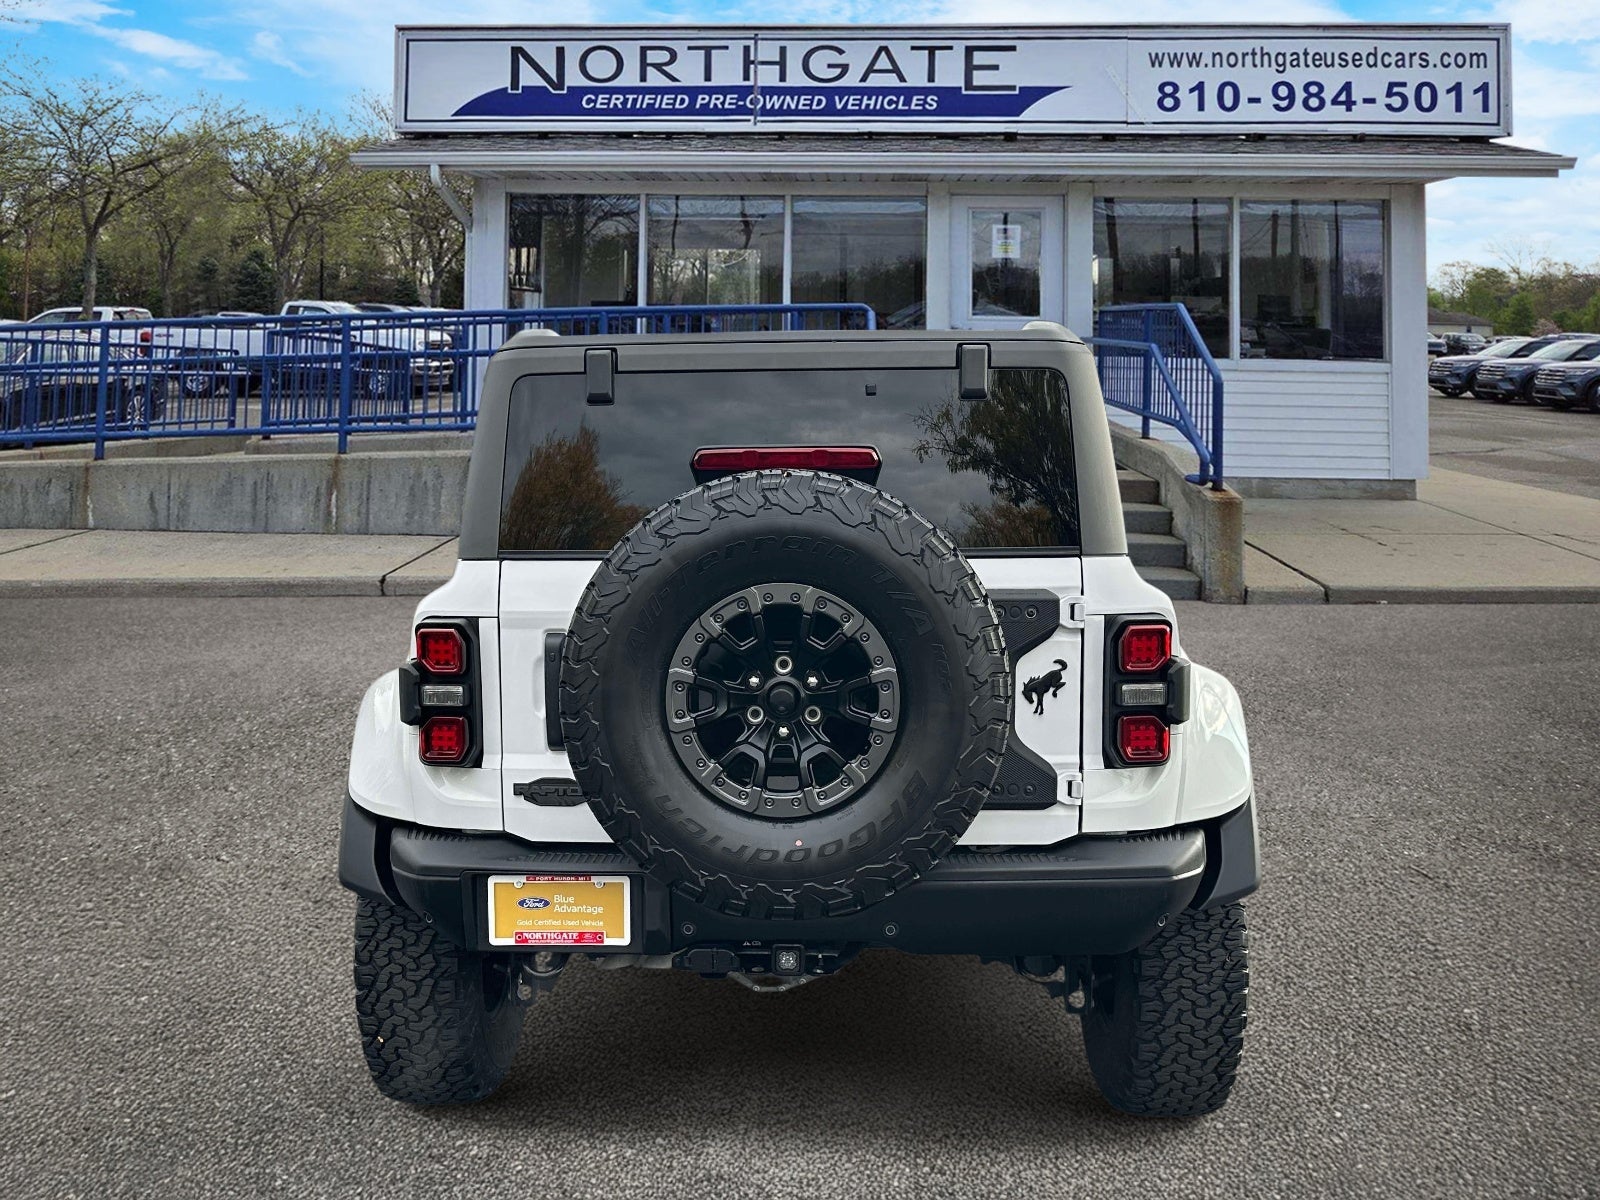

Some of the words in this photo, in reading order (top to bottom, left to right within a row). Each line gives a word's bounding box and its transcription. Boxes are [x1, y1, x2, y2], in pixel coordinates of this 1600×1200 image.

[1148, 46, 1489, 73] www.northgateusedcars.com
[509, 44, 1018, 93] NORTHGATE
[581, 93, 690, 111] CERTIFIED
[695, 94, 828, 111] PRE-OWNED
[834, 94, 939, 112] VEHICLES
[1156, 80, 1491, 114] 810-984-5011
[514, 784, 584, 801] RAPTO
[522, 898, 545, 909] Ford
[553, 895, 575, 903] Blue
[553, 905, 604, 914] Advantage
[581, 919, 604, 927] Vehicle
[522, 932, 580, 940] NORTHGATE
